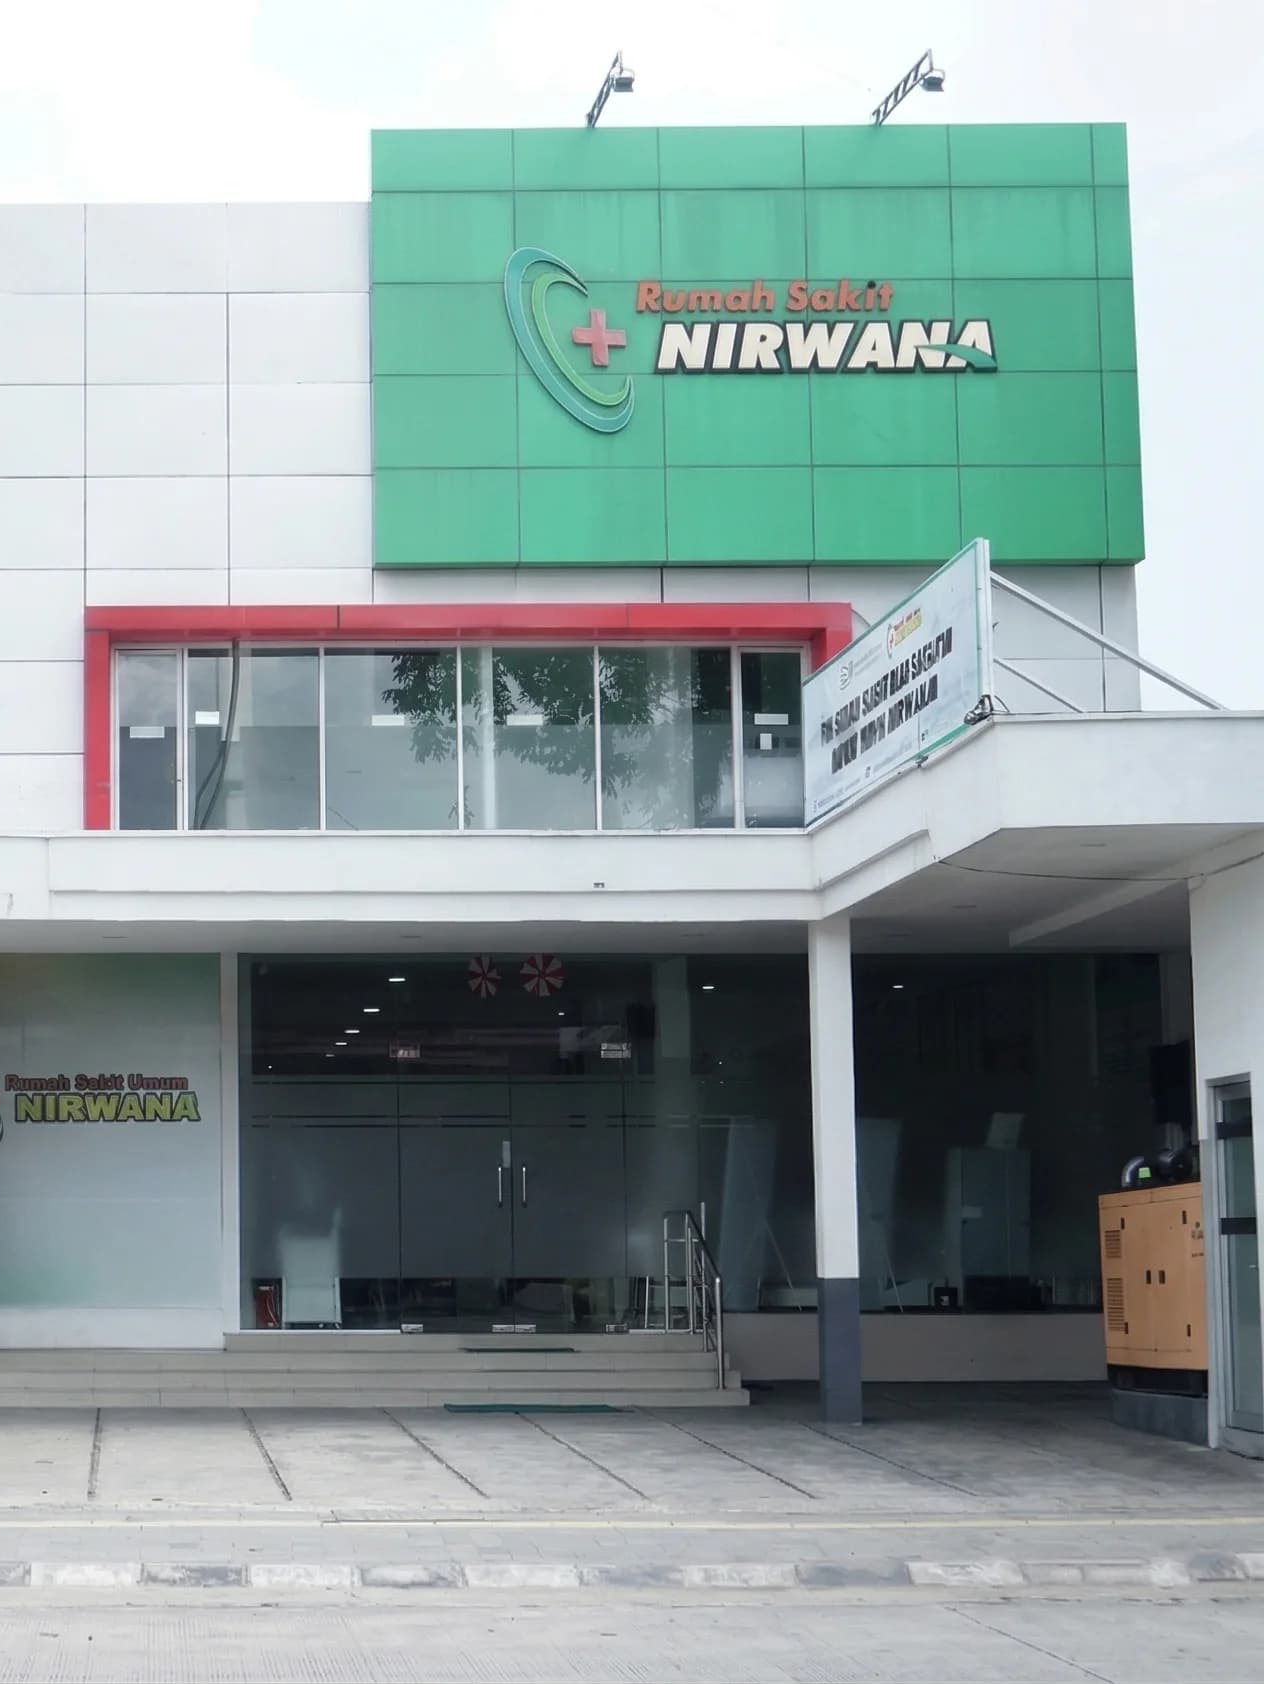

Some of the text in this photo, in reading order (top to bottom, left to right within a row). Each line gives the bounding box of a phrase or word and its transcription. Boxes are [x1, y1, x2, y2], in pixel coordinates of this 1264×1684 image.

[635, 279, 893, 312] Rumah Sakit
[655, 320, 998, 373] NIRWANA
[5, 1074, 70, 1091] Rumah
[128, 1073, 188, 1090] Umum
[15, 1092, 201, 1122] NIRWANA
